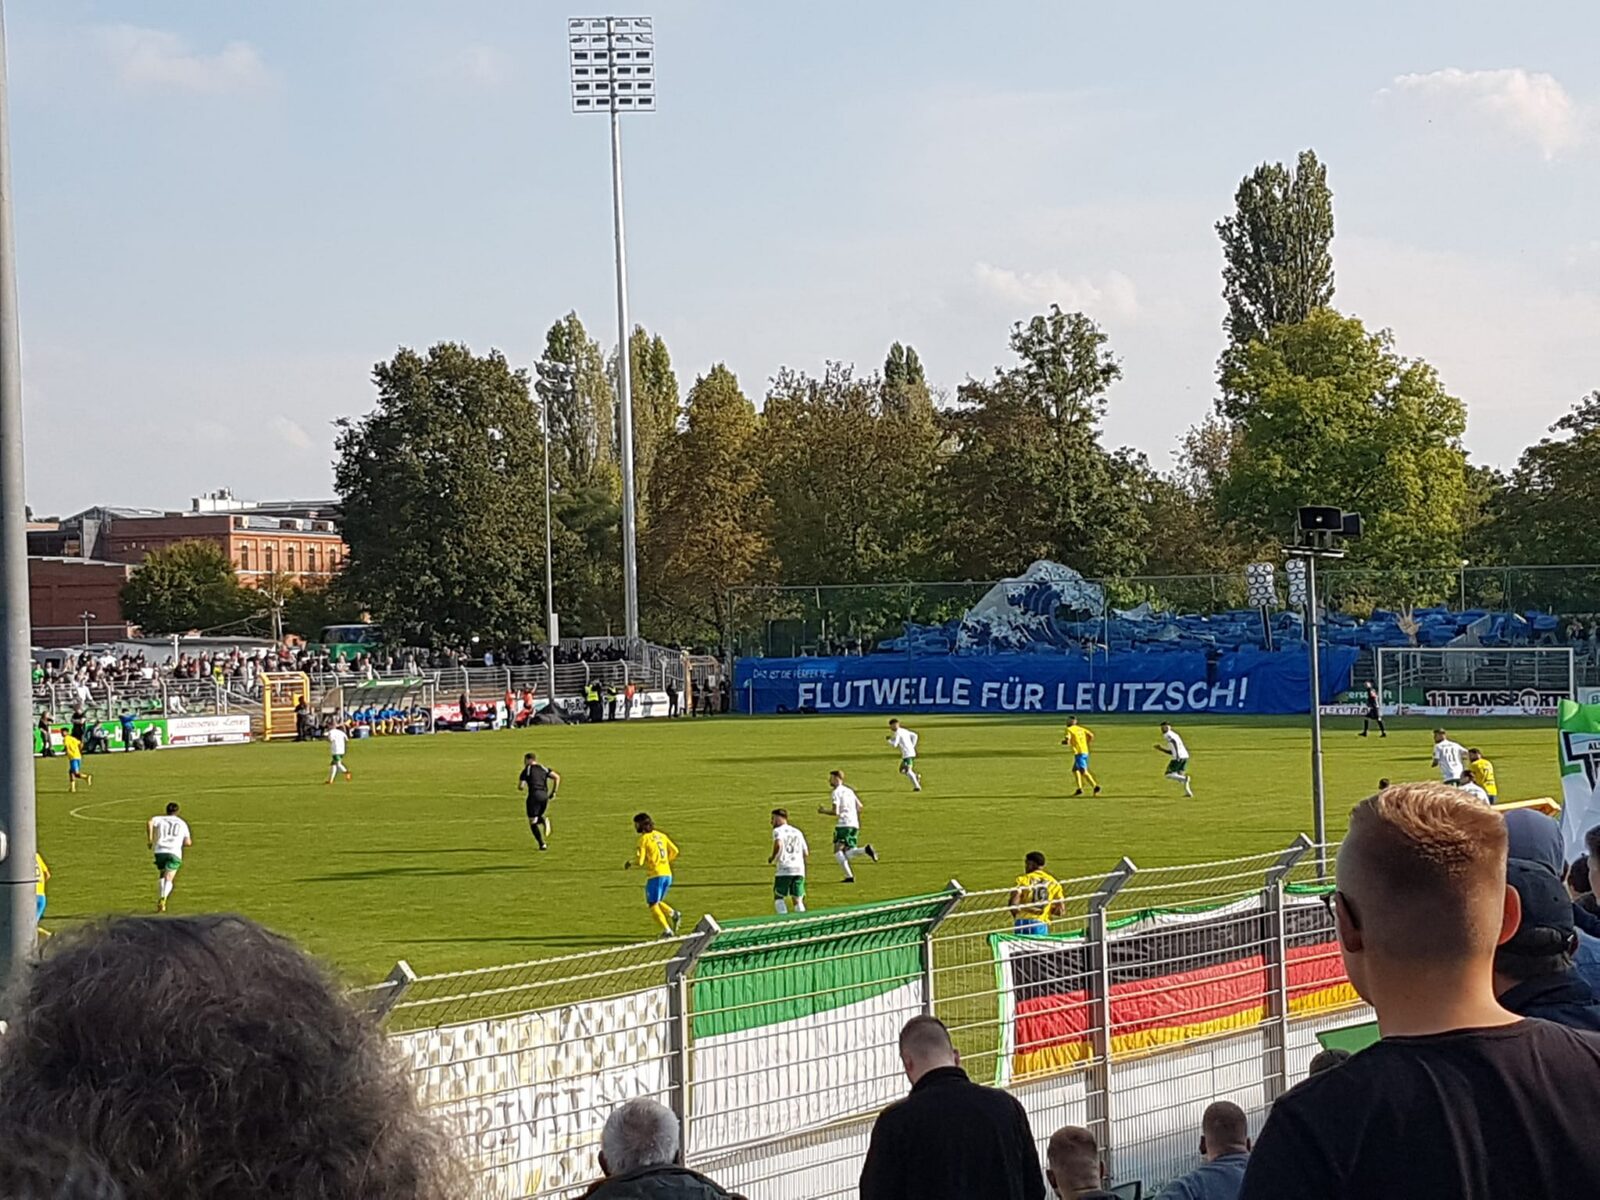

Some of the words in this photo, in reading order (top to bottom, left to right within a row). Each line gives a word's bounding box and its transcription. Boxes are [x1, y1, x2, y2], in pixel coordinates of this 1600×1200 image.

[798, 677, 972, 708] FLUTWELLE
[980, 676, 1044, 710] FÜR
[1057, 677, 1248, 711] LEUTZSCH!
